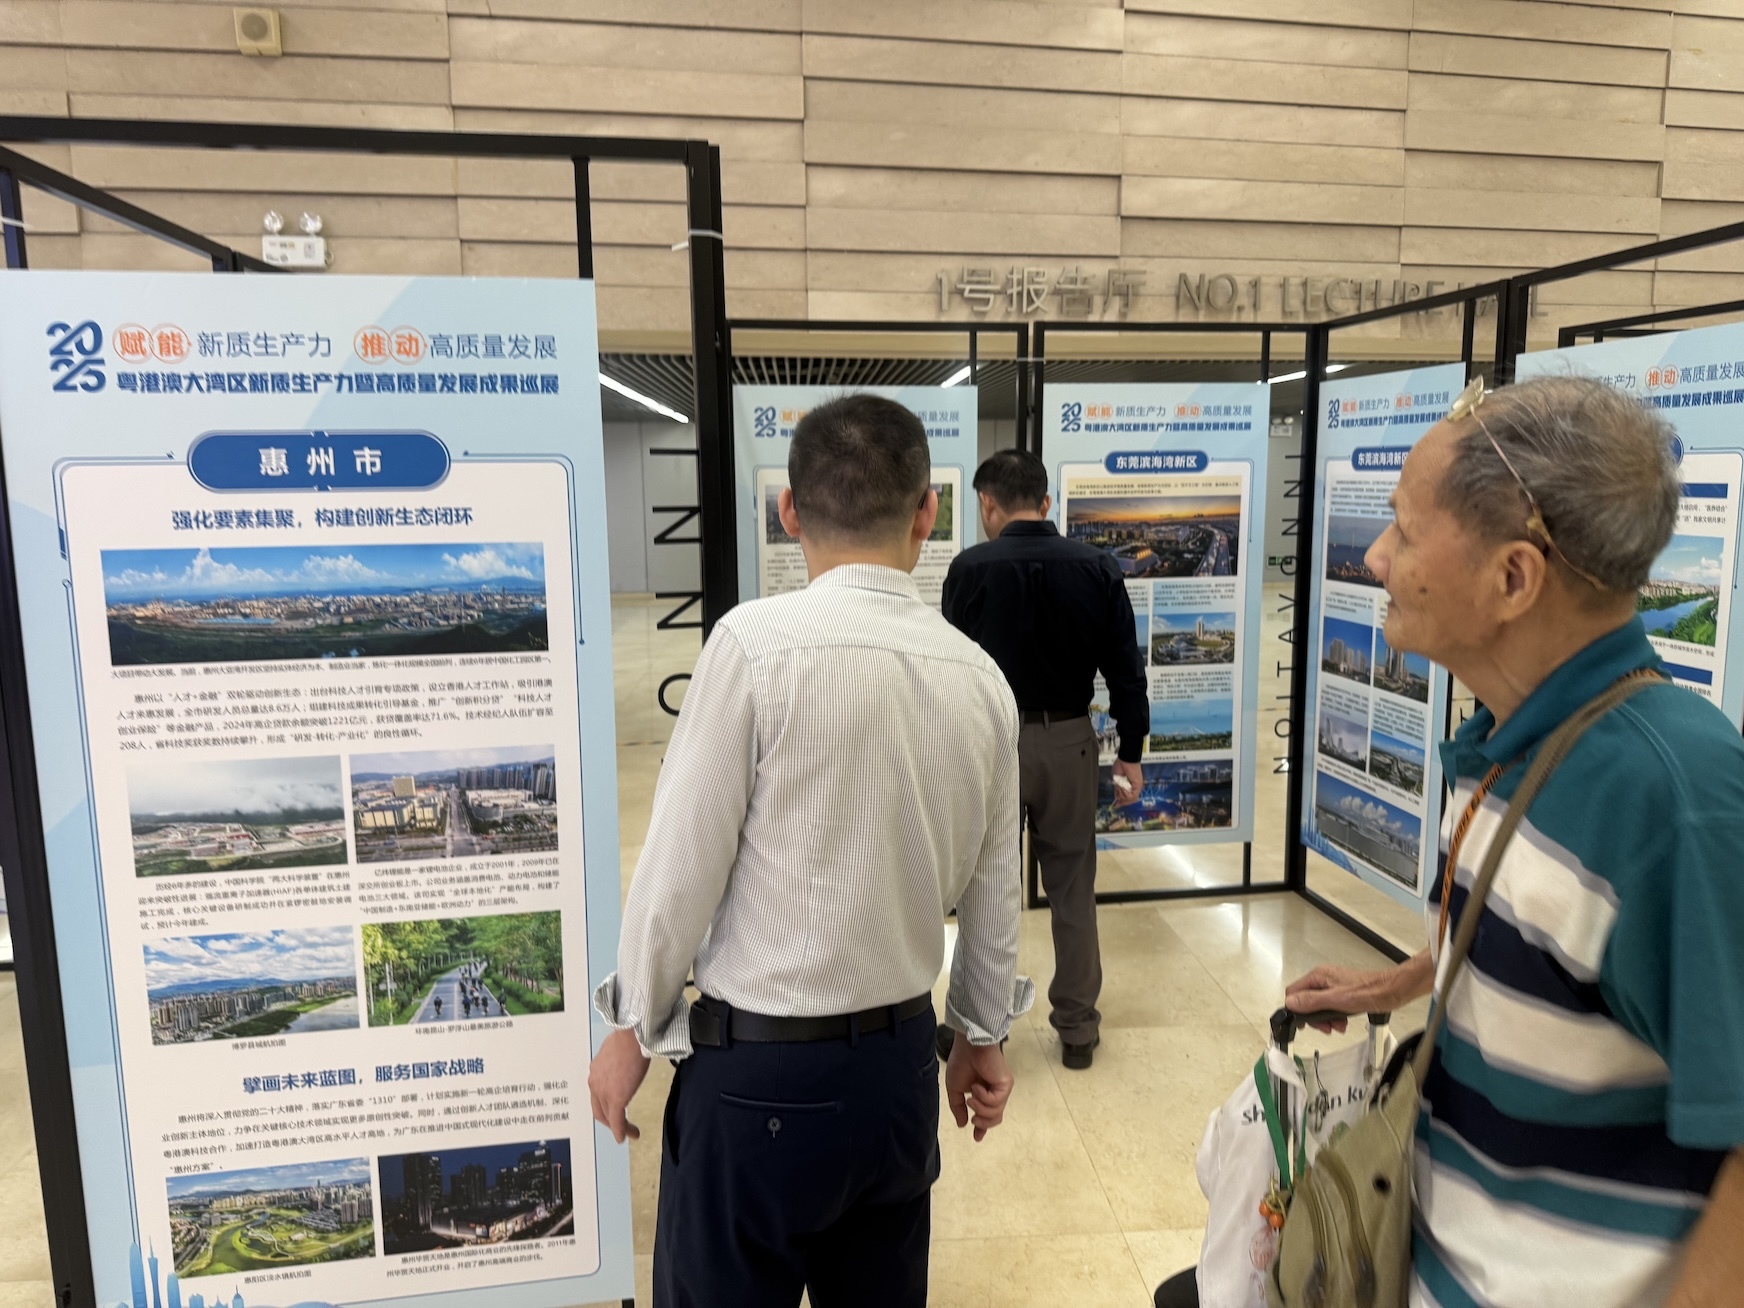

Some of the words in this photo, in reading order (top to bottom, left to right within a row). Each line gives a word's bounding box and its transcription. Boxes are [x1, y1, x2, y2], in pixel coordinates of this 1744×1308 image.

[936, 265, 1147, 314] 1号报告厅
[1176, 273, 1261, 312] NO.1
[116, 371, 560, 395] 粤港澳大湾区新质生产力暨高质量发展成果巡展
[1116, 455, 1198, 469] 东莞滨海湾新区
